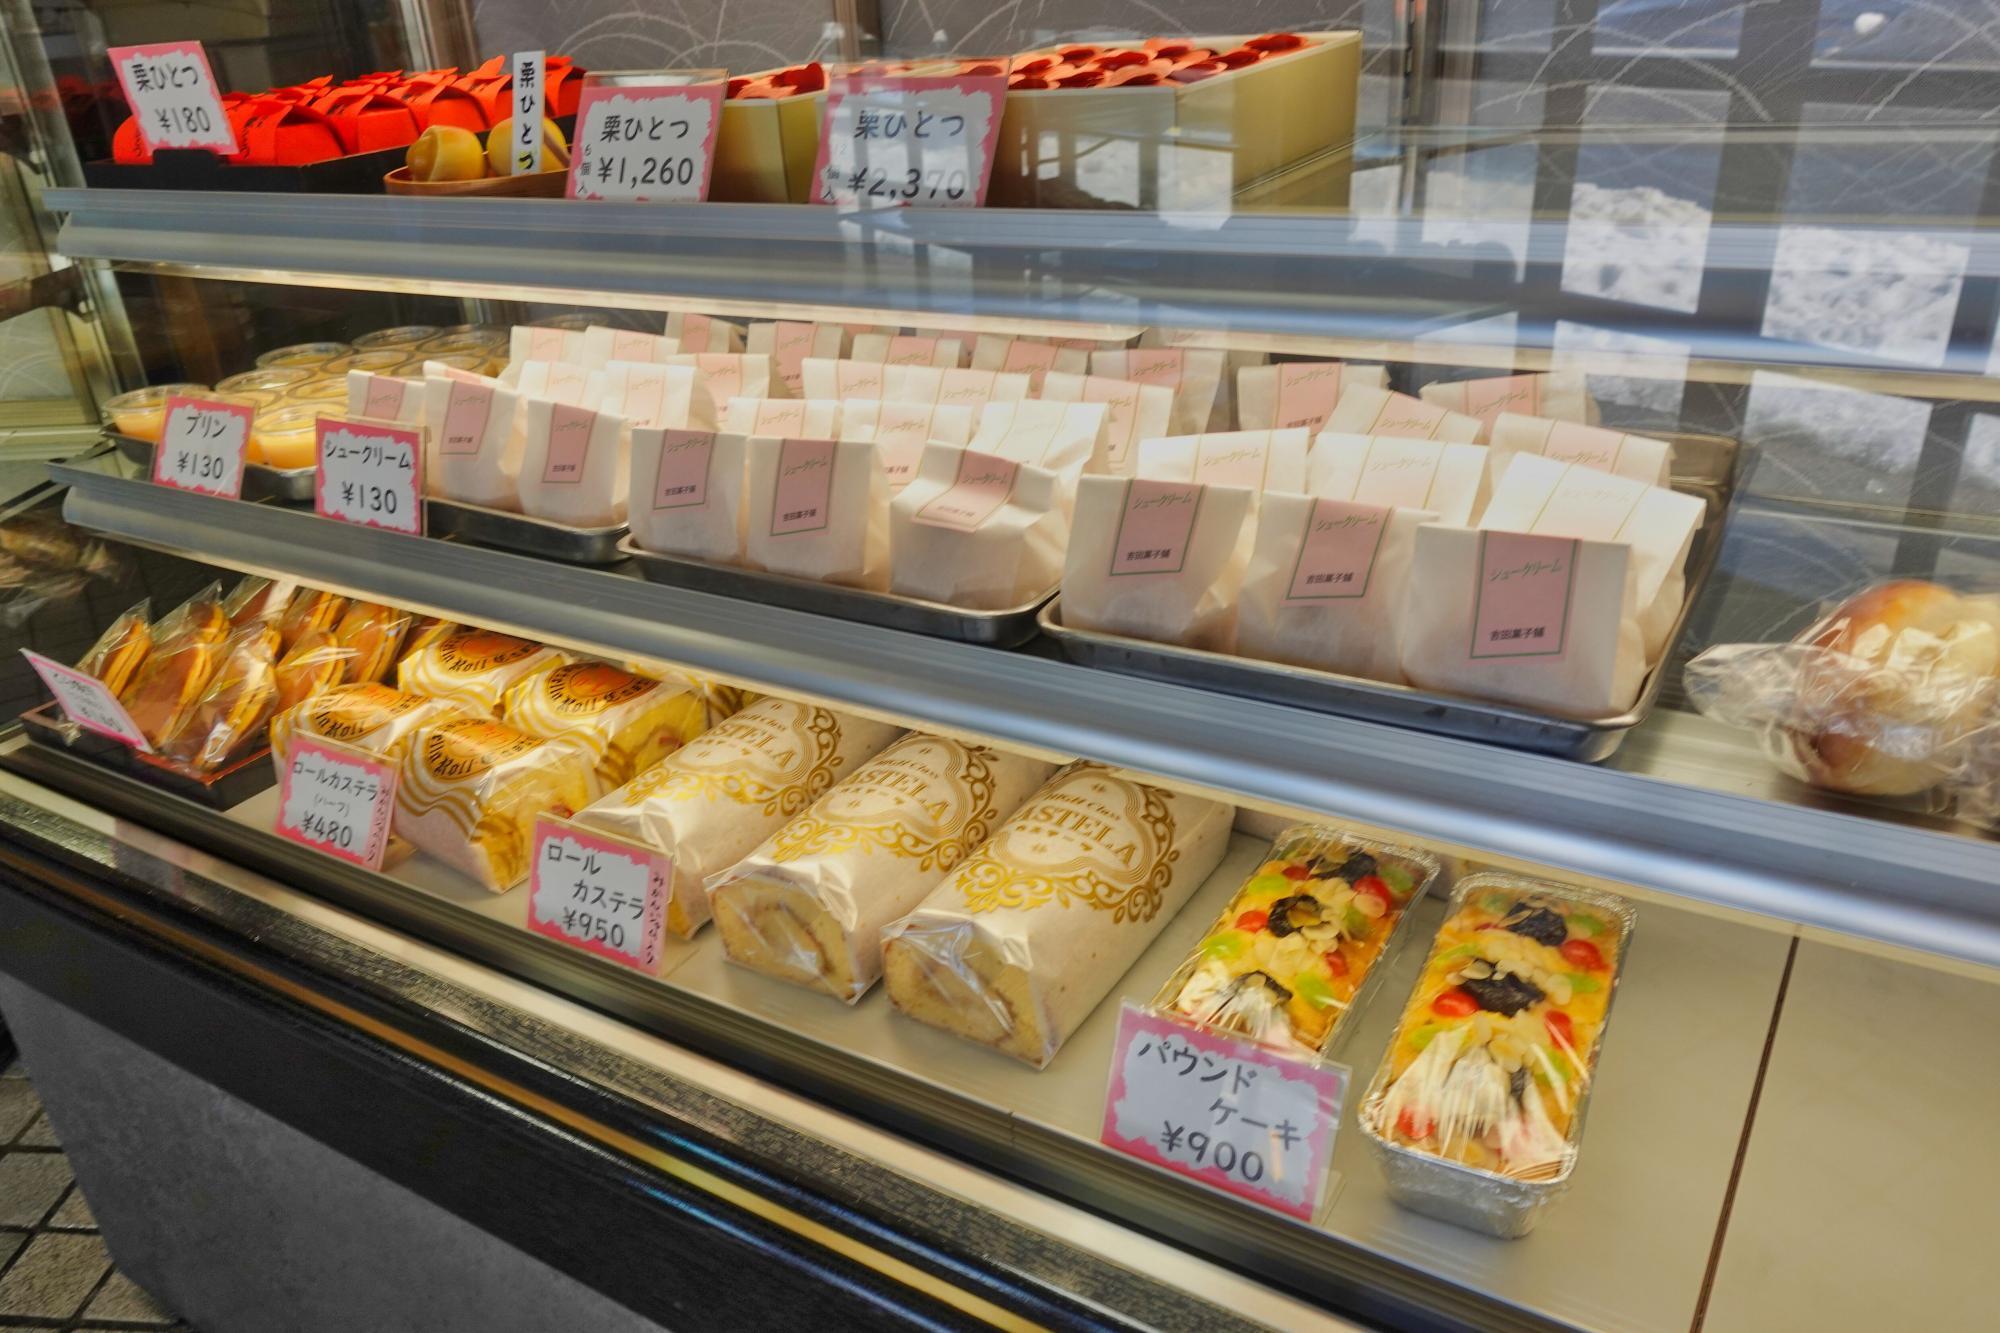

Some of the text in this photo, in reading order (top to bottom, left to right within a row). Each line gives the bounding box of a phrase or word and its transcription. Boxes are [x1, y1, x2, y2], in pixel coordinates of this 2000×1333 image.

[131, 61, 199, 91] 栗ひとつ
[155, 105, 211, 134] ¥180
[518, 61, 536, 171] 栗ひとつ
[600, 114, 690, 144] 栗ひとつ
[854, 110, 966, 140] 栗ひとつ
[597, 156, 694, 190] ¥1,260
[847, 166, 967, 200] ¥2,370
[185, 413, 226, 440] プリン
[177, 451, 224, 480] ¥130
[324, 440, 412, 469] シュークリーム
[342, 481, 397, 515] ¥130
[293, 760, 378, 801] ロールカステラ
[302, 815, 353, 848] ¥480
[546, 842, 602, 876] ロール
[572, 879, 645, 920] カステラ
[562, 906, 625, 948] ¥950
[1137, 1041, 1258, 1095] パウンド
[1209, 1098, 1302, 1151] ケーキ
[1160, 1120, 1264, 1182] ¥900
